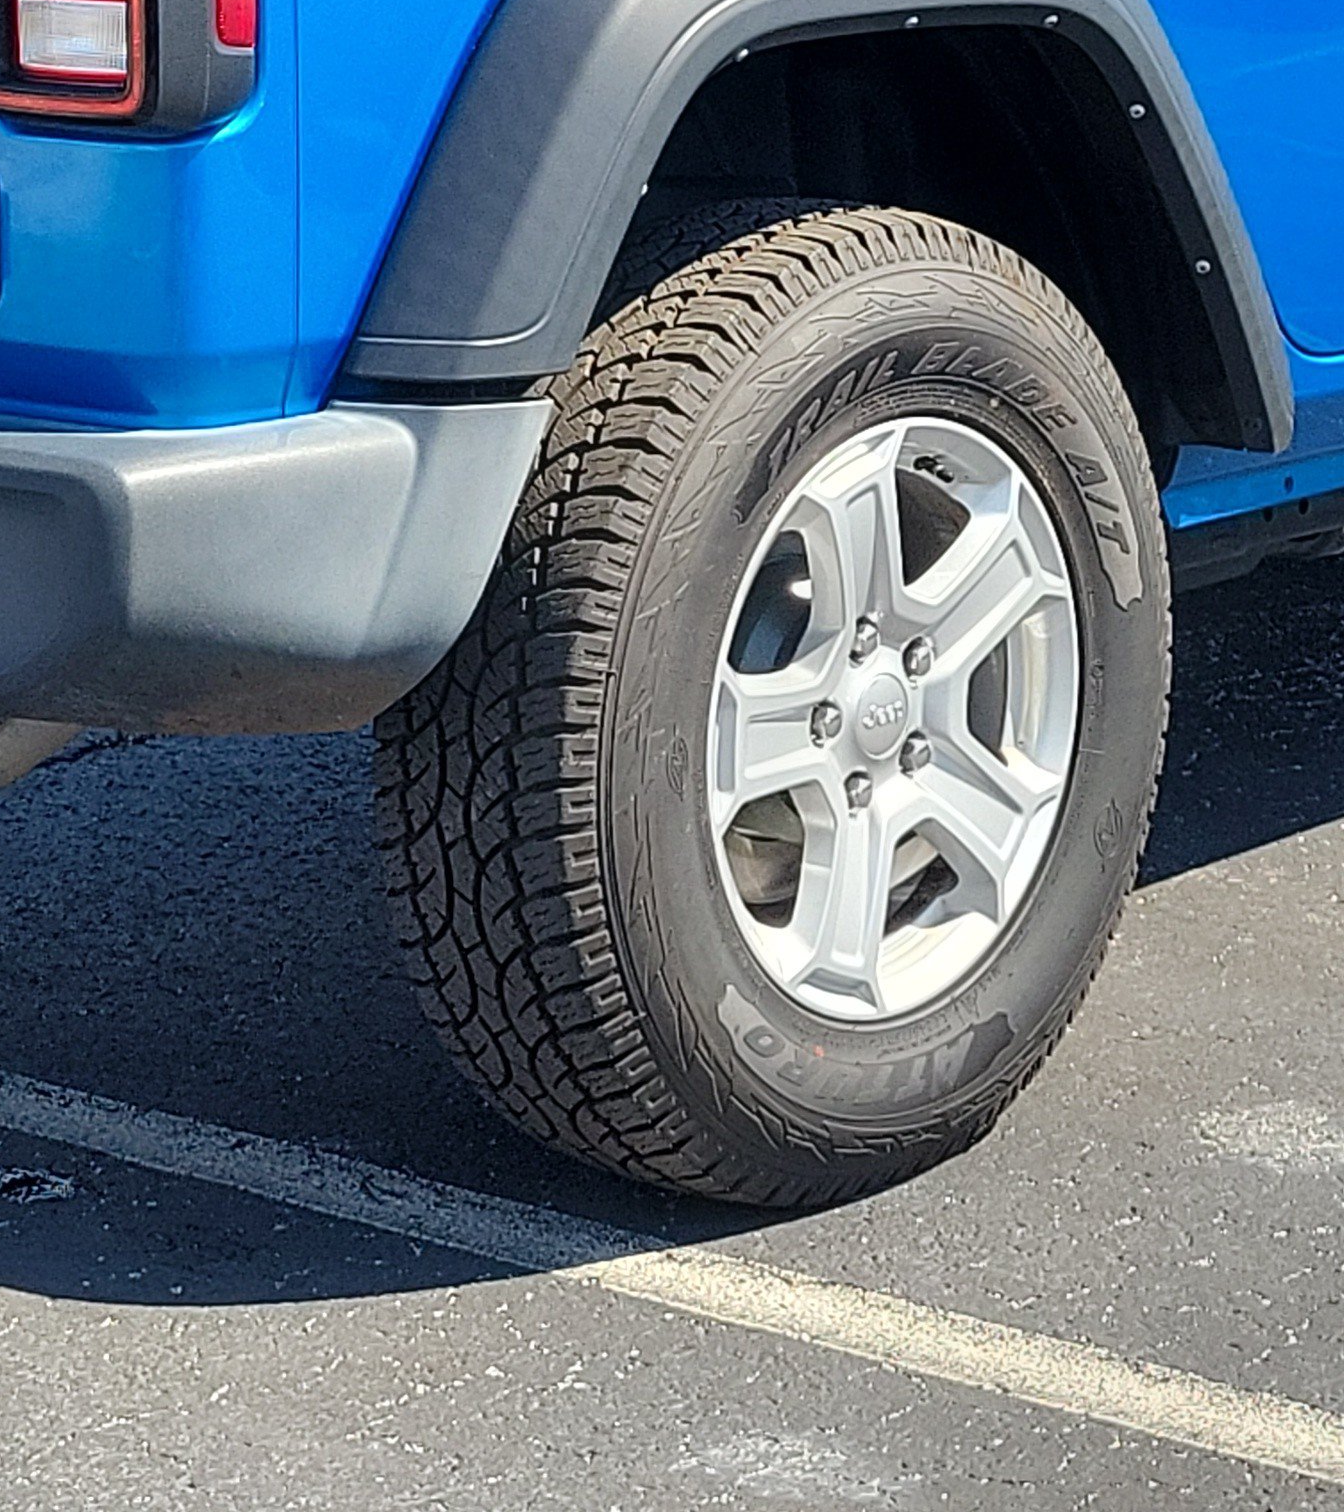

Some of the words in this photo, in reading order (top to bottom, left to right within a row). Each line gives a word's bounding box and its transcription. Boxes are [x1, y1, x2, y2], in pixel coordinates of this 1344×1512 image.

[768, 350, 899, 489] TRAIL
[910, 339, 1078, 433] BLADE
[1064, 448, 1131, 555] A/T
